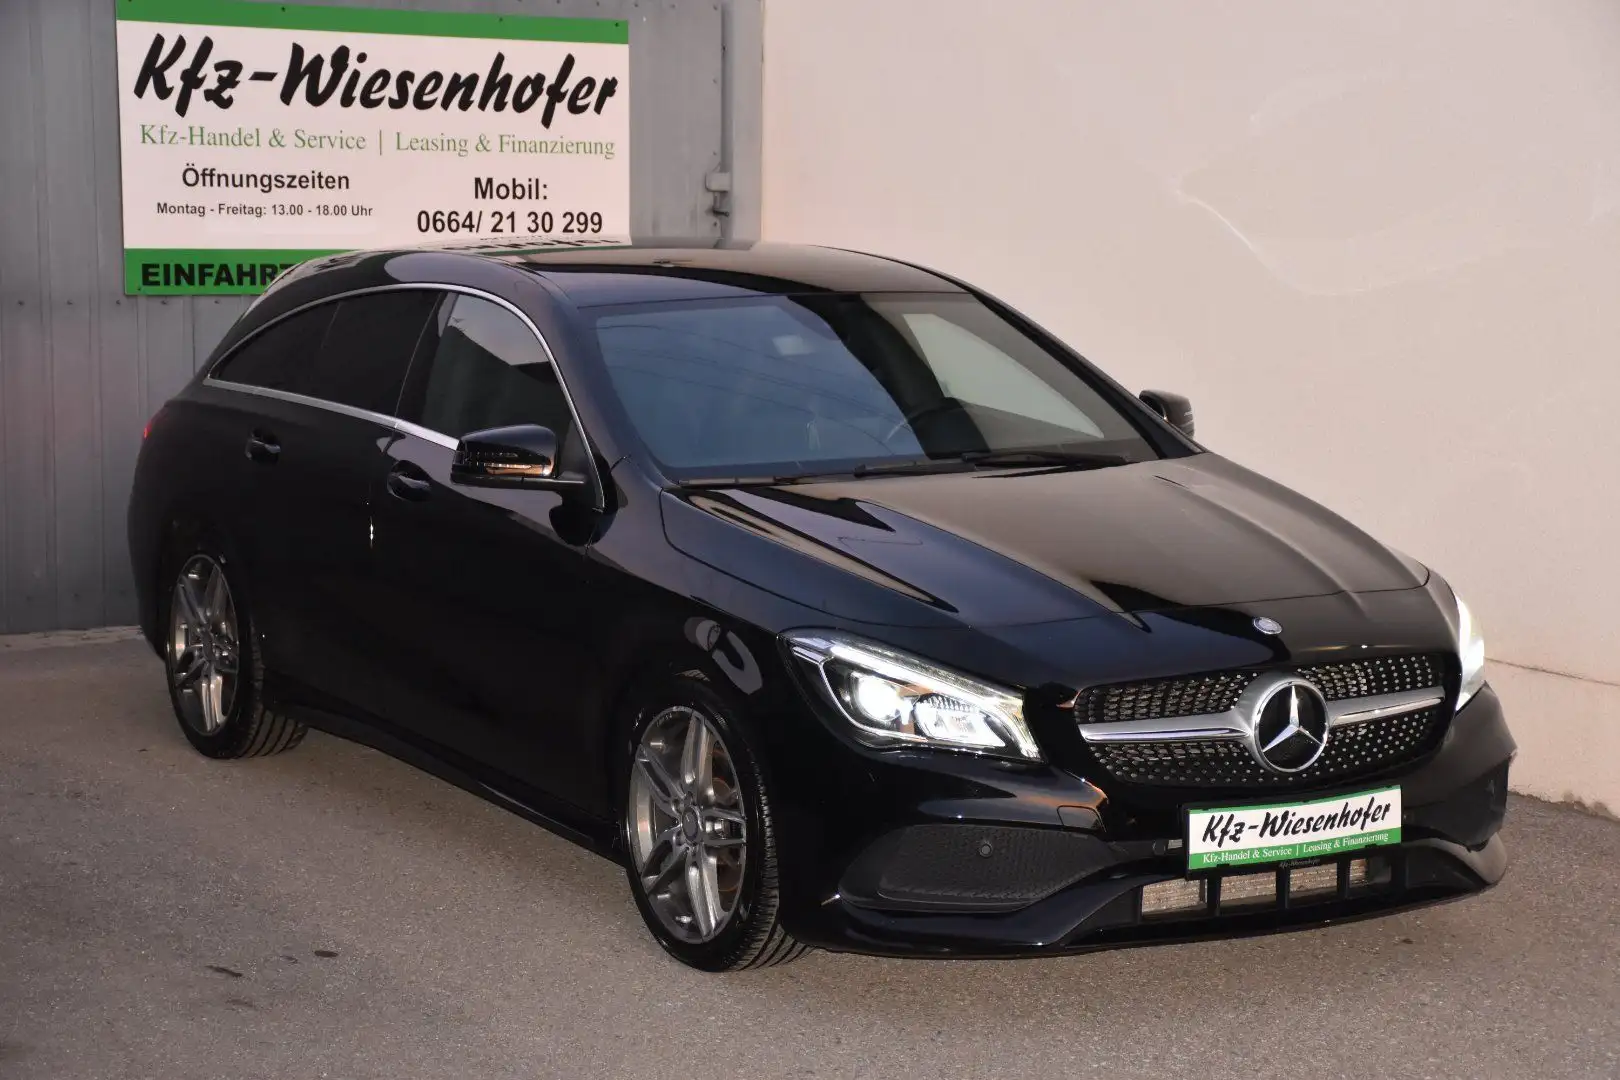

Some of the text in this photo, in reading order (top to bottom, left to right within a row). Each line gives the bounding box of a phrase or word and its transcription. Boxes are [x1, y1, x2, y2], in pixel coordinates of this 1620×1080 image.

[133, 33, 619, 130] Kfz-Wiesenhofer
[140, 124, 261, 148] Kfz-Handel
[268, 127, 287, 148] &
[294, 128, 366, 150] Service
[396, 131, 469, 158] Leasing
[475, 133, 492, 153] &
[498, 134, 616, 159] Finanzierung
[182, 163, 350, 193] Öffnungszeiten
[474, 177, 548, 200] Mobil:
[156, 202, 206, 218] Montag
[218, 203, 267, 218] Freitag:
[272, 204, 304, 216] 13.00
[316, 205, 347, 216] 18.00
[351, 205, 374, 217] Uhr
[417, 210, 603, 234] 0664/ 21 30 299
[1202, 797, 1391, 848] Kfz-Wiesenhofer
[1203, 851, 1250, 863] Kfz-Handel
[1252, 850, 1260, 859] &
[1262, 847, 1292, 857] Service
[1303, 841, 1332, 853] Leasing
[1333, 839, 1340, 848] &
[1342, 832, 1388, 847] Finanzierung
